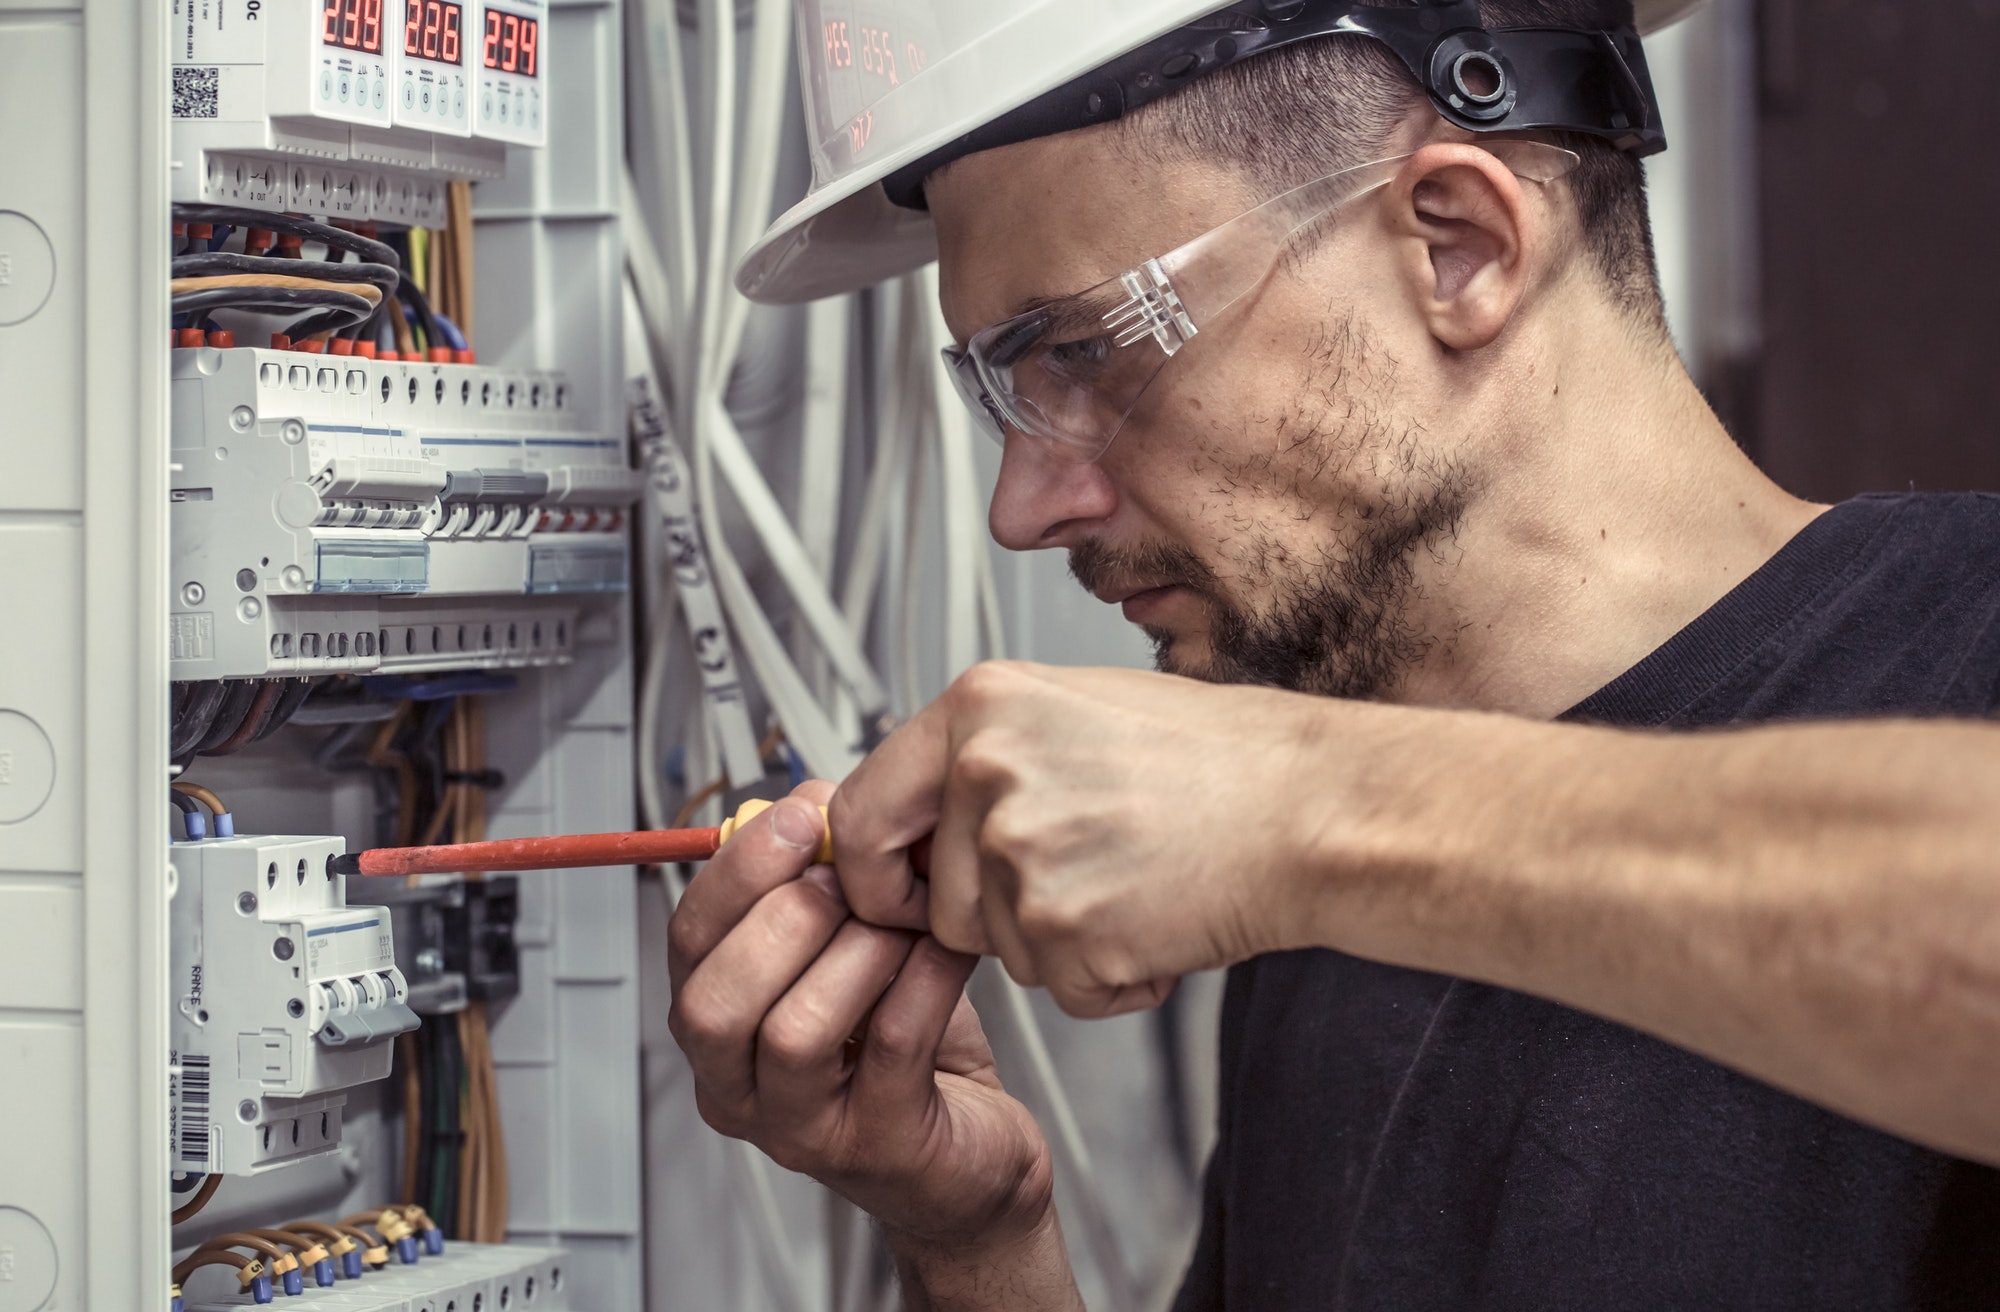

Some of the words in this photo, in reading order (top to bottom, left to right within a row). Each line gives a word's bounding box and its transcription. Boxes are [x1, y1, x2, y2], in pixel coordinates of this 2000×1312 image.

[404, 0, 460, 63] 226
[483, 10, 538, 76] 234
[191, 965, 201, 1005] RANCE
[250, 1263, 263, 1274] 5
